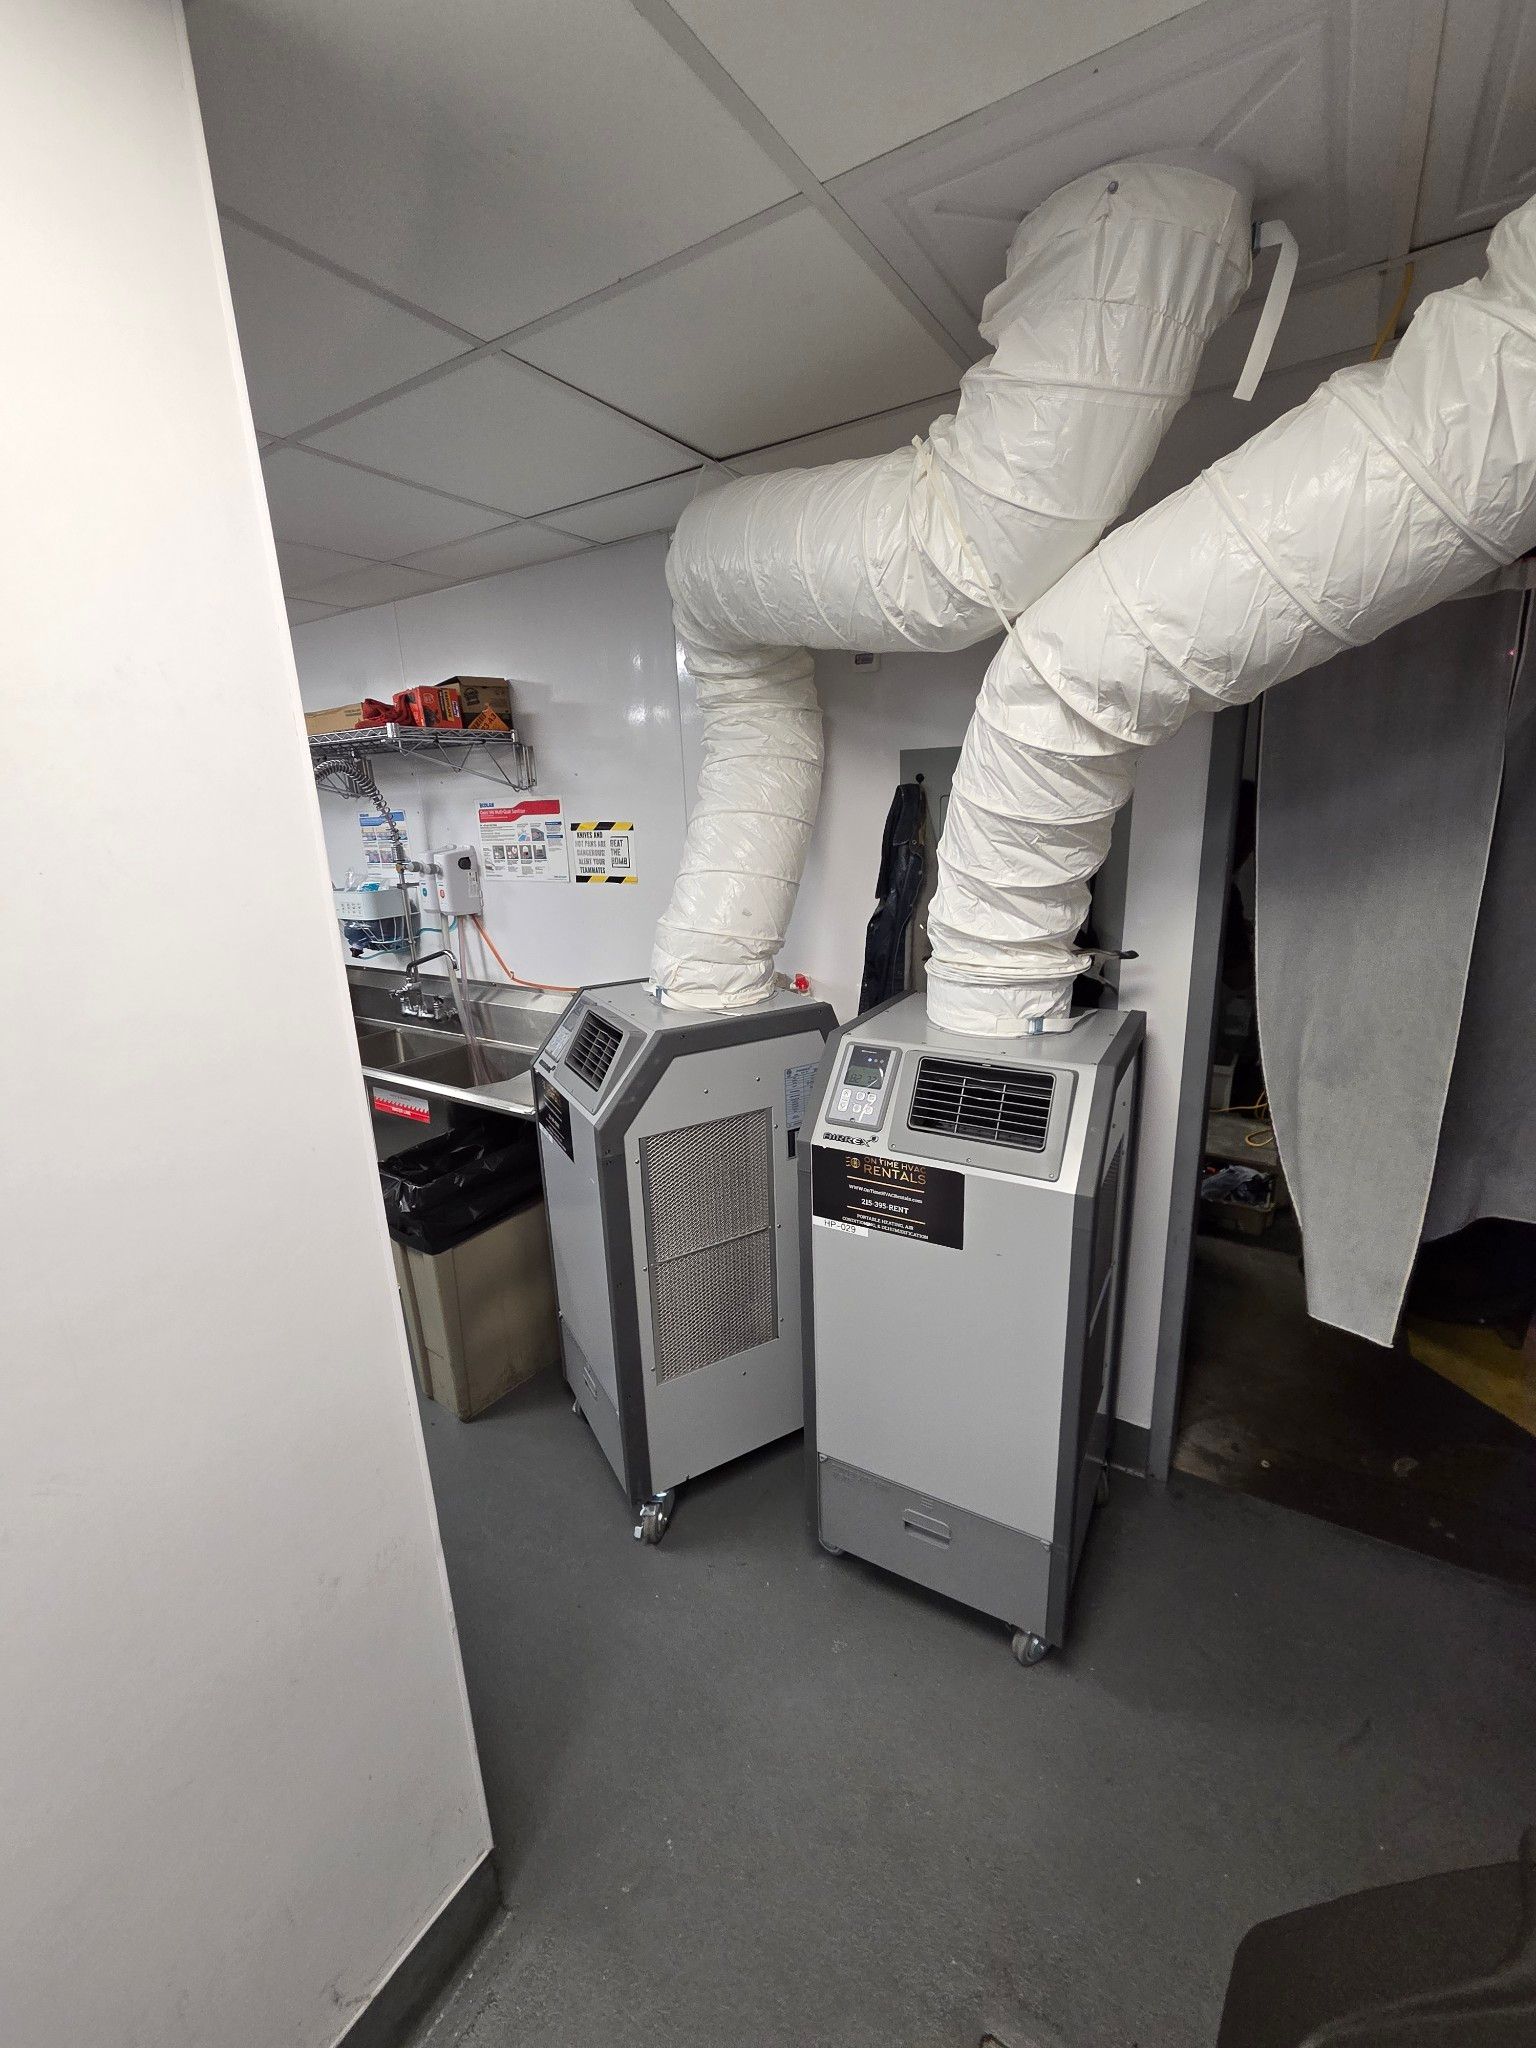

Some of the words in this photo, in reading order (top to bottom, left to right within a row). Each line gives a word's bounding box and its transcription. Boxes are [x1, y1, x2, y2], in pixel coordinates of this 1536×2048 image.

[577, 831, 592, 839] KNIVES
[610, 848, 621, 856] THE
[863, 1156, 877, 1165] ON
[879, 1158, 900, 1169] TIME
[901, 1163, 927, 1174] HVAC
[863, 1163, 927, 1185] RENTALS
[861, 1198, 910, 1215] 215-395-RENT
[824, 1219, 857, 1234] HP-029
